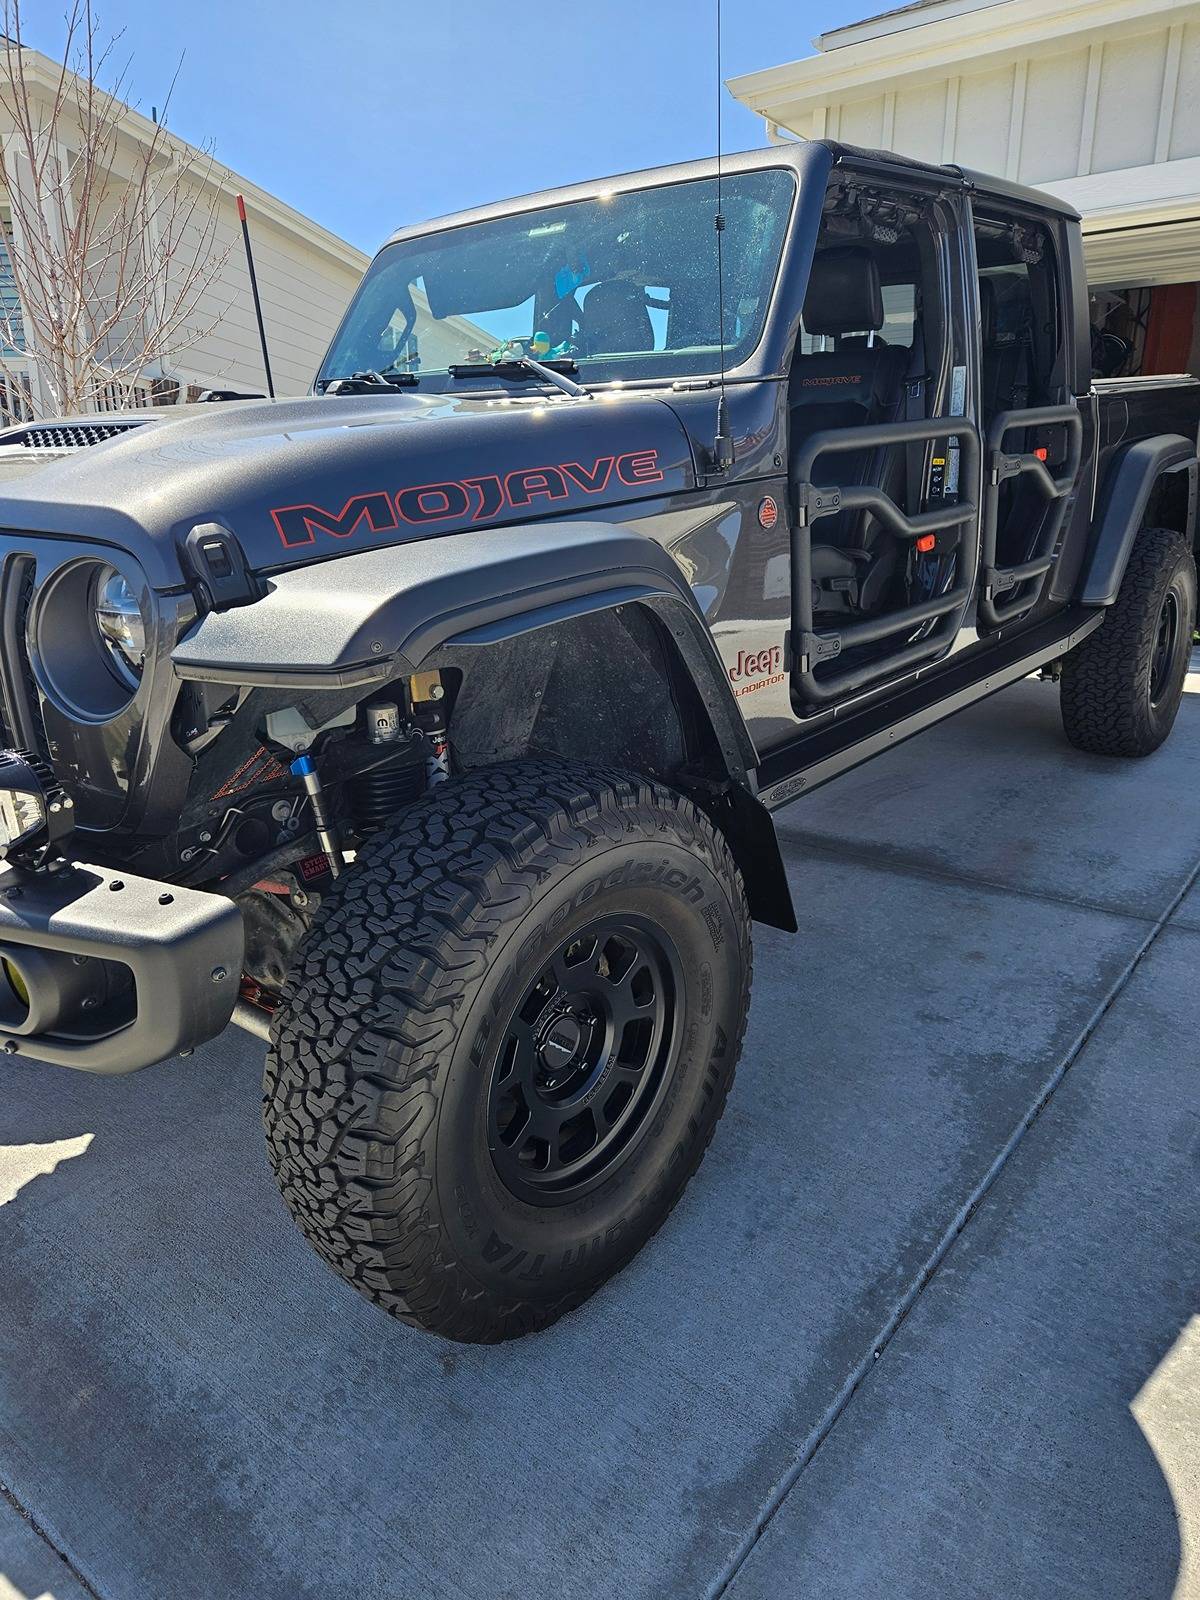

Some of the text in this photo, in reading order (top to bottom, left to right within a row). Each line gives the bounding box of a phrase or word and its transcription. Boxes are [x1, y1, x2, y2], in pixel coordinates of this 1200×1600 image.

[801, 375, 862, 388] MOJAVE
[269, 449, 664, 549] MOJAVE
[729, 645, 784, 682] Jeep
[733, 673, 785, 697] LADIATOR
